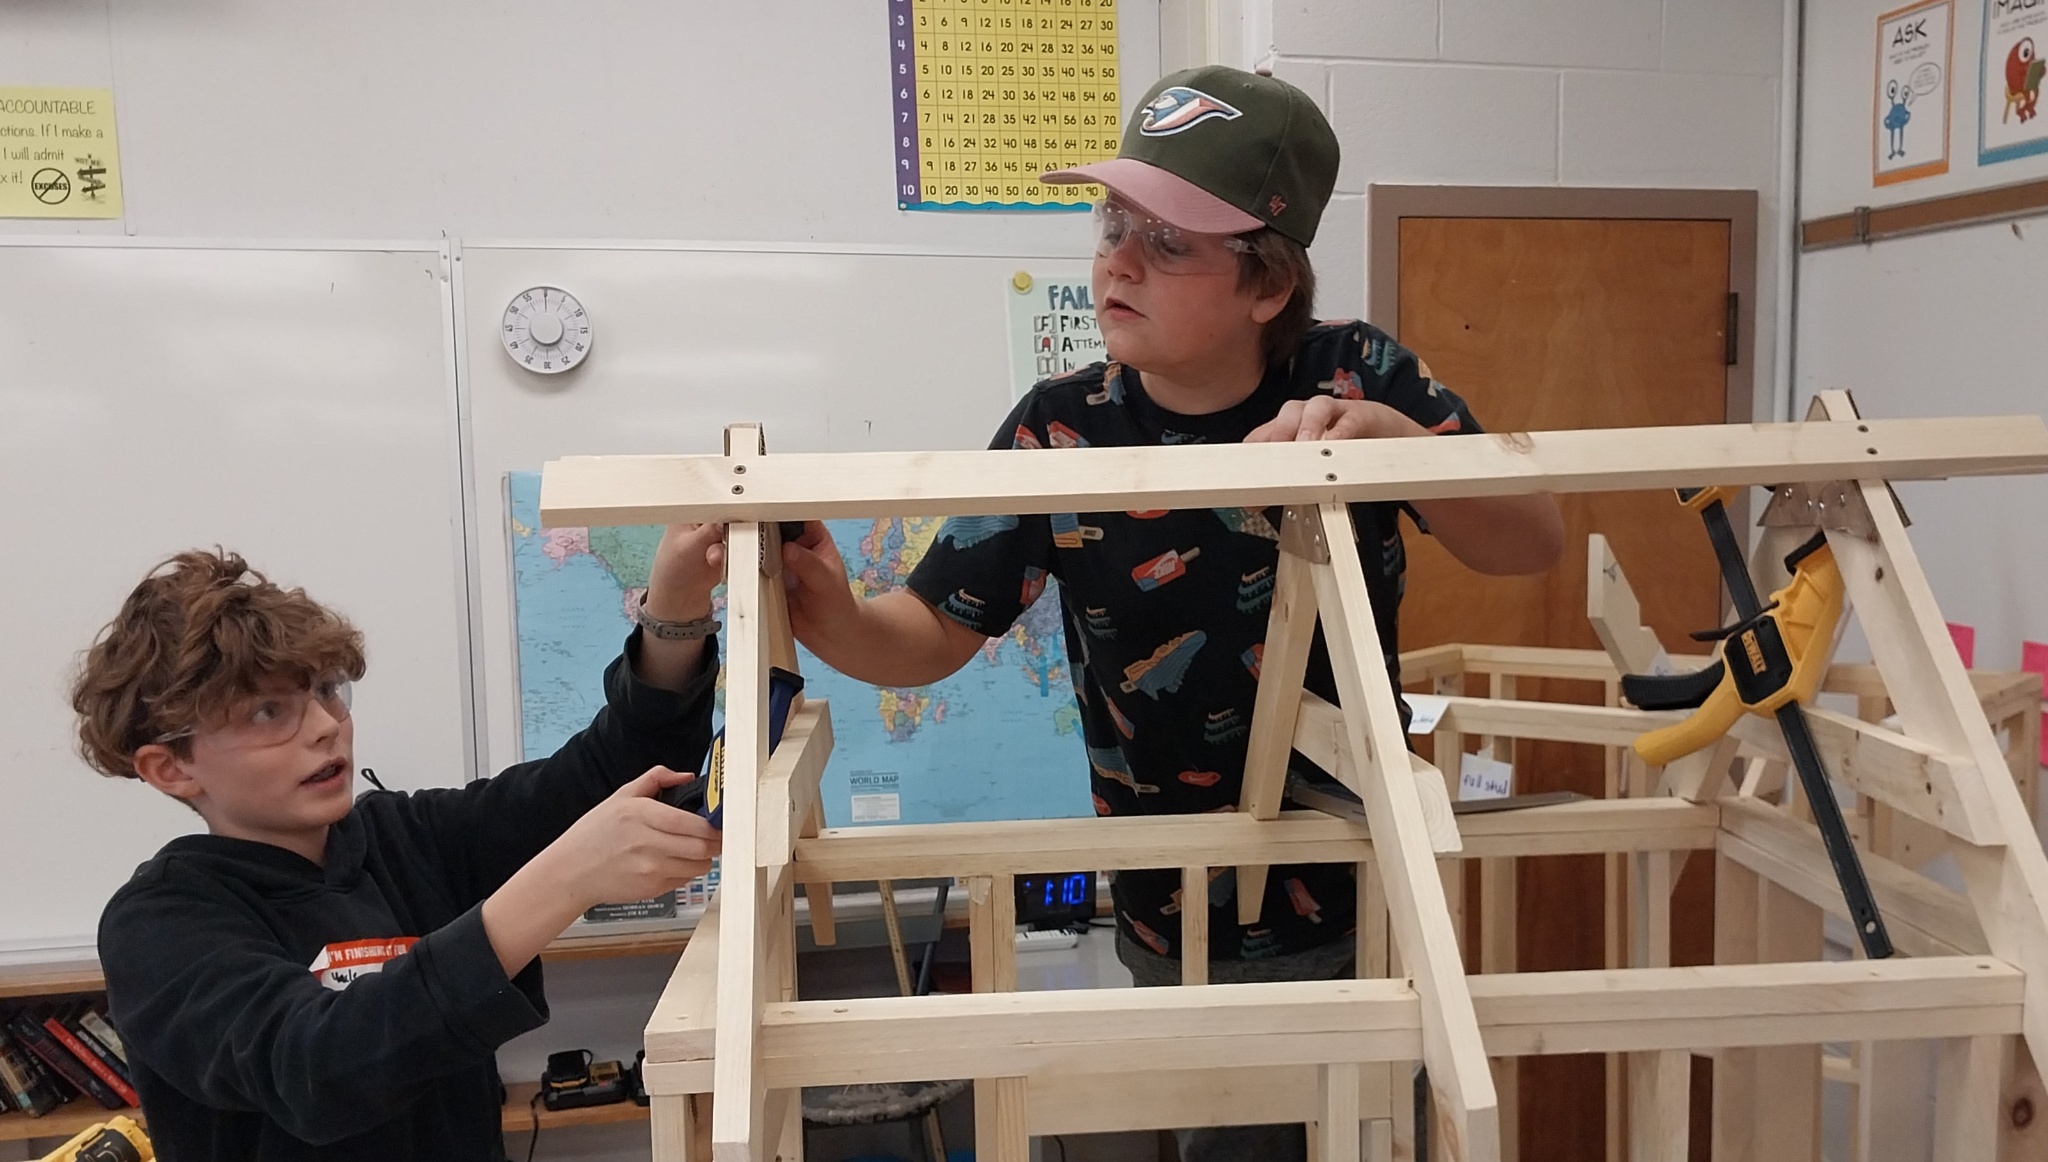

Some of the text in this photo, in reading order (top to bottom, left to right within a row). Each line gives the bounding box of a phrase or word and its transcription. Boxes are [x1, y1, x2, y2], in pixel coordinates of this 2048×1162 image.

[897, 14, 1114, 31] 3 3 6 9 12 15 18 21 24 27 30
[1892, 18, 1928, 47] ASK
[897, 39, 1115, 55] 4 4 8 12 16 20 24 28 32 36 40
[899, 63, 1115, 78] 5 5 10 15 20 25 30 35 40 45 50
[900, 88, 1116, 103] 6 6 12 18 24 30 36 42 48 54 60
[901, 112, 1117, 126] 7 7 14 21 28 35 42 49 56 63 70
[41, 124, 51, 137] If
[54, 124, 58, 137] I
[62, 124, 92, 138] make
[96, 129, 104, 139] a
[902, 136, 1117, 150] 8 8 16 24 32 40 48 56 64 72 80
[3, 147, 65, 160] I will admit
[901, 159, 909, 170] 9
[925, 160, 934, 171] 9
[944, 160, 956, 172] 18
[964, 161, 977, 172] 27
[984, 161, 998, 172] 36
[1003, 161, 1018, 173] 45
[1024, 161, 1038, 173] 54
[1045, 162, 1058, 171] 63
[11, 171, 23, 184] it!
[34, 182, 68, 191] EXCUSES
[902, 184, 1098, 197] 10 10 20 30 40 50 60 70 80 90
[1048, 285, 1095, 310] FAIL
[574, 308, 583, 318] 10
[580, 326, 588, 334] 15
[543, 361, 552, 369] 30
[850, 775, 899, 784] WORLD MAP
[1463, 774, 1508, 795] full stud
[1044, 874, 1087, 906] 1:10
